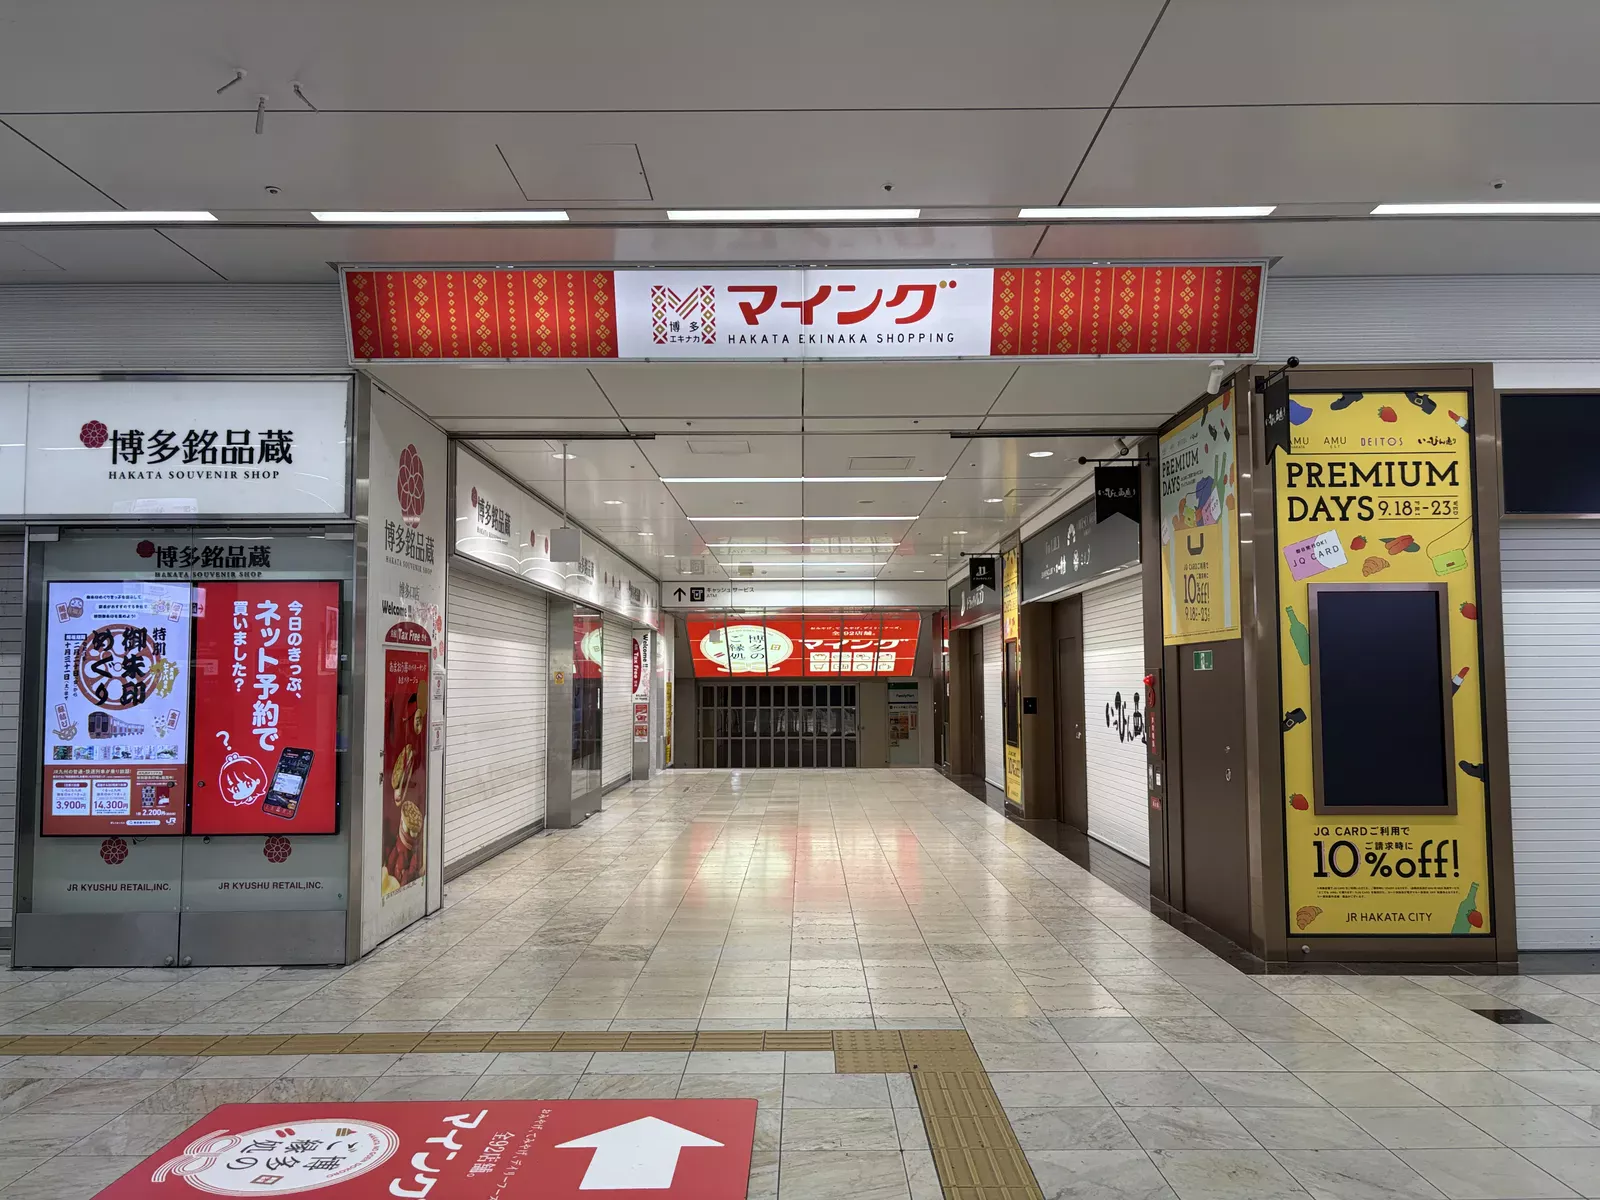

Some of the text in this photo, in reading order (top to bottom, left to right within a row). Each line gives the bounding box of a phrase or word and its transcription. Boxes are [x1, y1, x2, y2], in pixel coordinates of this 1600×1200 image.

[727, 280, 957, 325] マイング
[669, 321, 700, 333] 博多
[669, 335, 700, 343] エキナカ
[728, 332, 955, 344] HAKATA EKINAKA SHOPPING
[109, 429, 294, 465] 博多銘品蔵
[1324, 437, 1347, 445] AMU
[1361, 437, 1403, 447] DEITOS
[1162, 447, 1199, 478] PREMIUM
[108, 470, 280, 480] HAKATA SOUVENIR SHOP
[1286, 461, 1460, 488] PREMIUM
[1162, 476, 1180, 496] DAYS
[1287, 495, 1375, 522] DAYS
[384, 519, 435, 565] 博多銘品蔵
[154, 545, 271, 568] 博多銘品蔵
[1293, 545, 1340, 567] JQ CARD
[385, 555, 433, 575] HAKATA SOUVENIR SHOP
[382, 600, 407, 616] Welcome
[152, 627, 167, 656] 特別
[398, 628, 408, 640] Tax
[408, 630, 421, 641] Free
[232, 601, 249, 692] 買いました？
[286, 600, 303, 698] 今日のきっぷ、
[797, 639, 909, 649] マイング
[91, 627, 116, 706] めぐり
[120, 626, 148, 706] 御朱印
[252, 599, 281, 751] ネット予約で
[56, 801, 87, 810] 3,900円
[94, 801, 129, 809] 14,300円
[1314, 827, 1330, 836] JQ
[1365, 841, 1414, 850] ご請求時に
[66, 883, 171, 892] JR KYUSHU RETAIL,INC.
[218, 881, 323, 890] JR KYUSHU RETAIL,INC.
[1345, 912, 1432, 922] JR HAKATA CITY
[240, 1139, 358, 1153] ご縁処
[467, 1131, 515, 1177] 全92店舗。
[226, 1155, 347, 1171] 博多の
